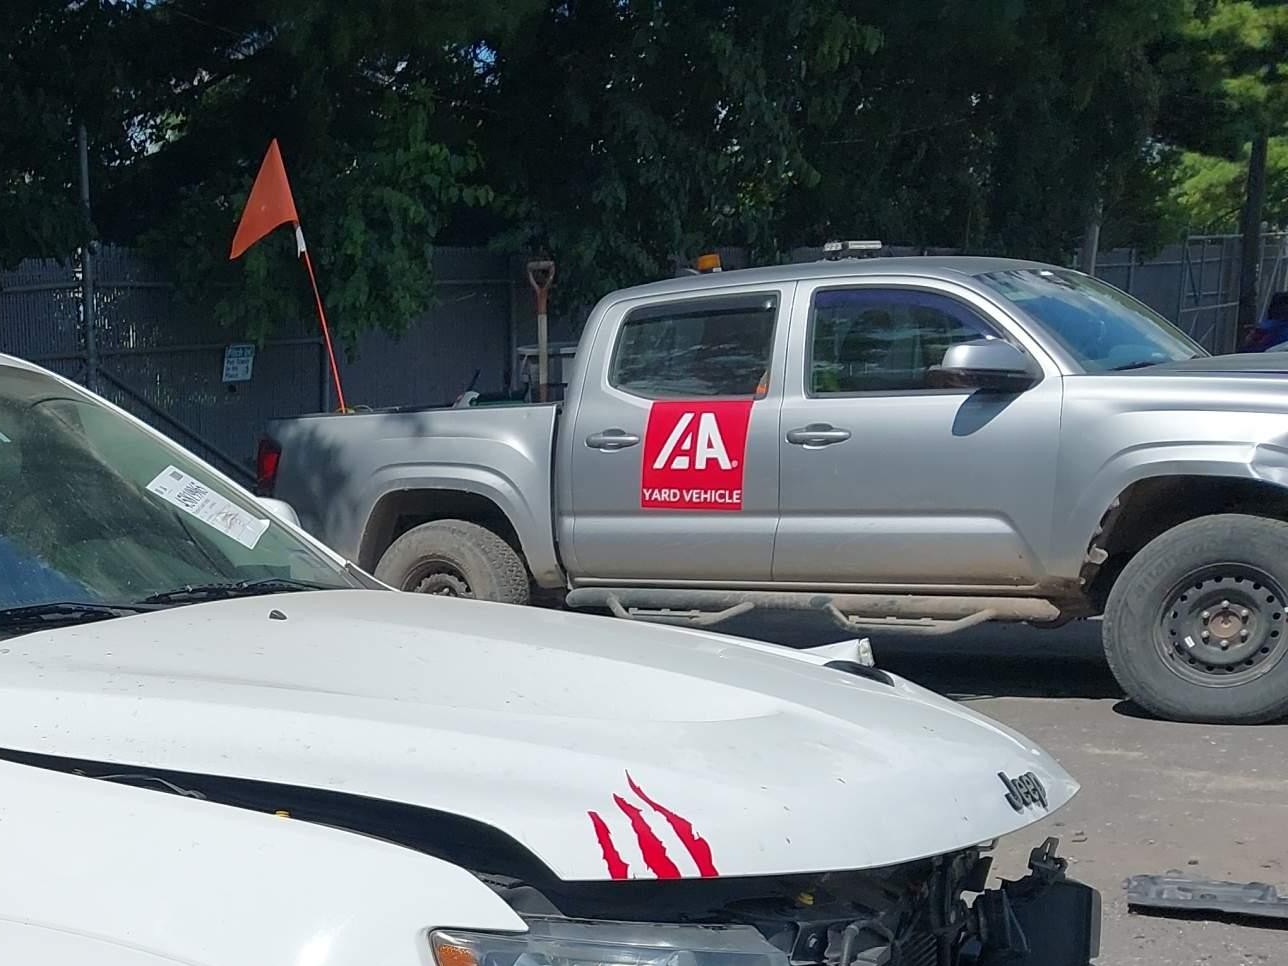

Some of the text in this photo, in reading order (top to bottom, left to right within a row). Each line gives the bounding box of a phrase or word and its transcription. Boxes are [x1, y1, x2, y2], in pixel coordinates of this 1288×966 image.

[643, 488, 741, 503] YARD VEHICLE
[997, 771, 1048, 811] Jeep
